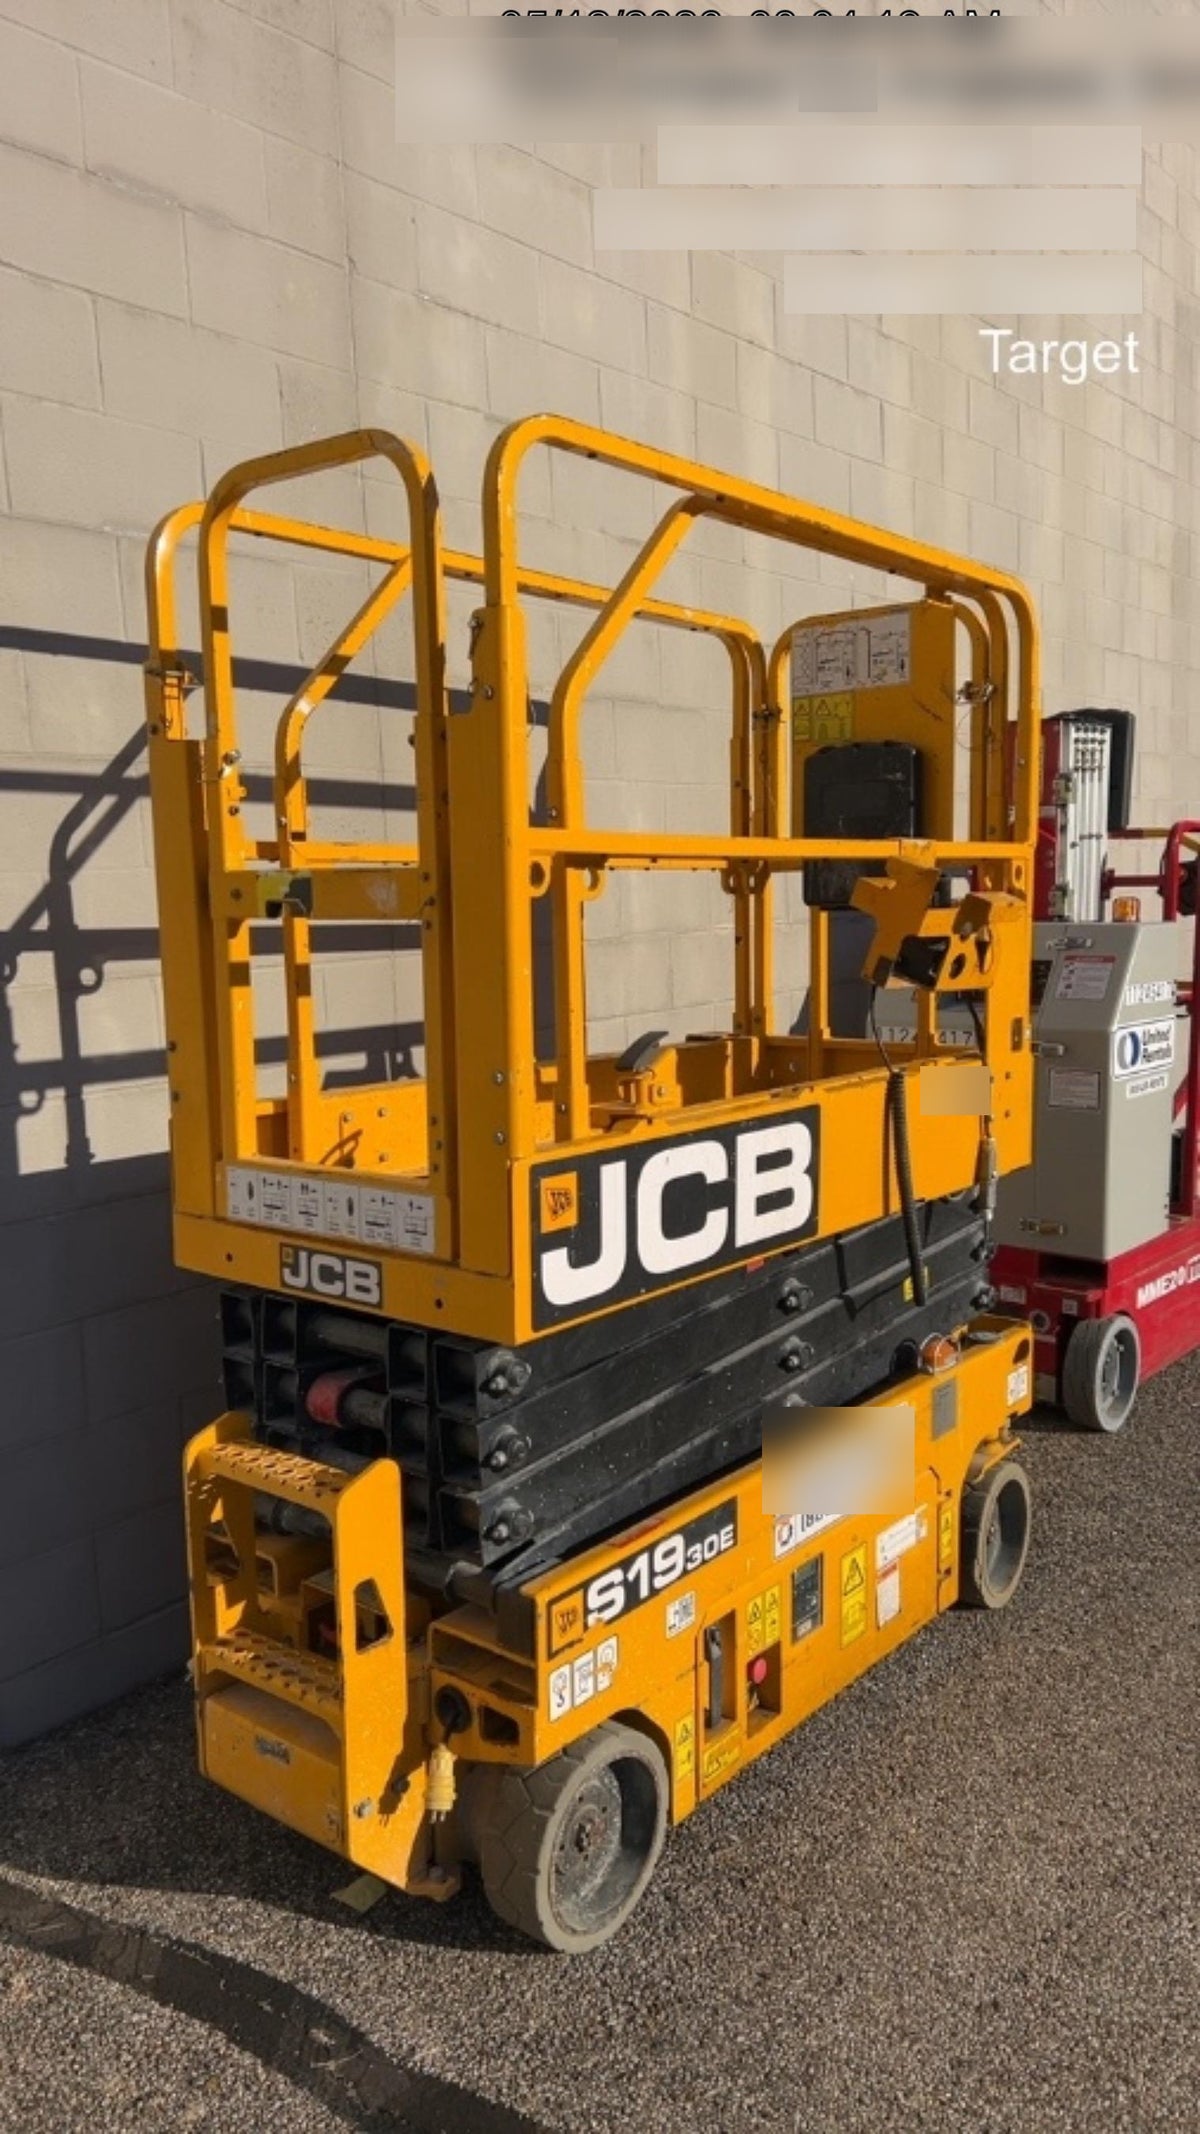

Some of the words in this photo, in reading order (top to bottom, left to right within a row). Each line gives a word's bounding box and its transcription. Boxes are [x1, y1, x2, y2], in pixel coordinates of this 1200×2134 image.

[1142, 1025, 1171, 1046] United
[541, 1122, 813, 1306] JCB
[283, 1251, 380, 1304] JCB
